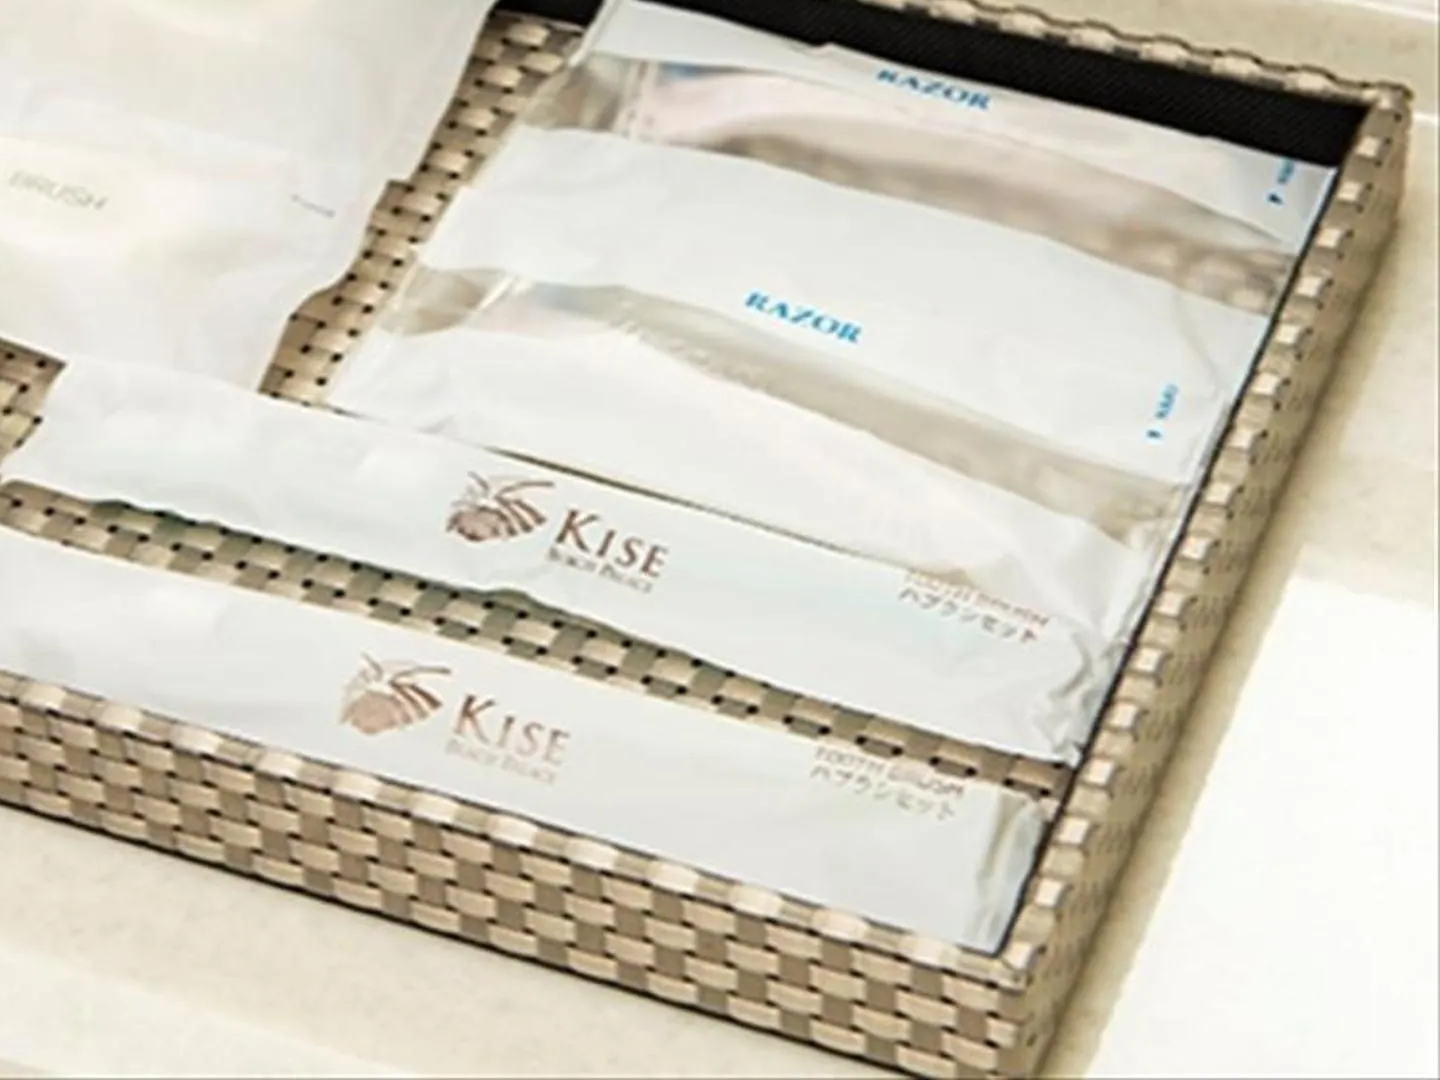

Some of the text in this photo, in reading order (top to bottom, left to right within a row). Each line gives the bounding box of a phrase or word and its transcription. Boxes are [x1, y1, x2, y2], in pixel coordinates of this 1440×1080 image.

[876, 66, 994, 114] RAZOR
[8, 168, 109, 213] BRUSH
[743, 289, 865, 348] RAZOR
[555, 508, 671, 579] KISE
[453, 693, 571, 766] KISE
